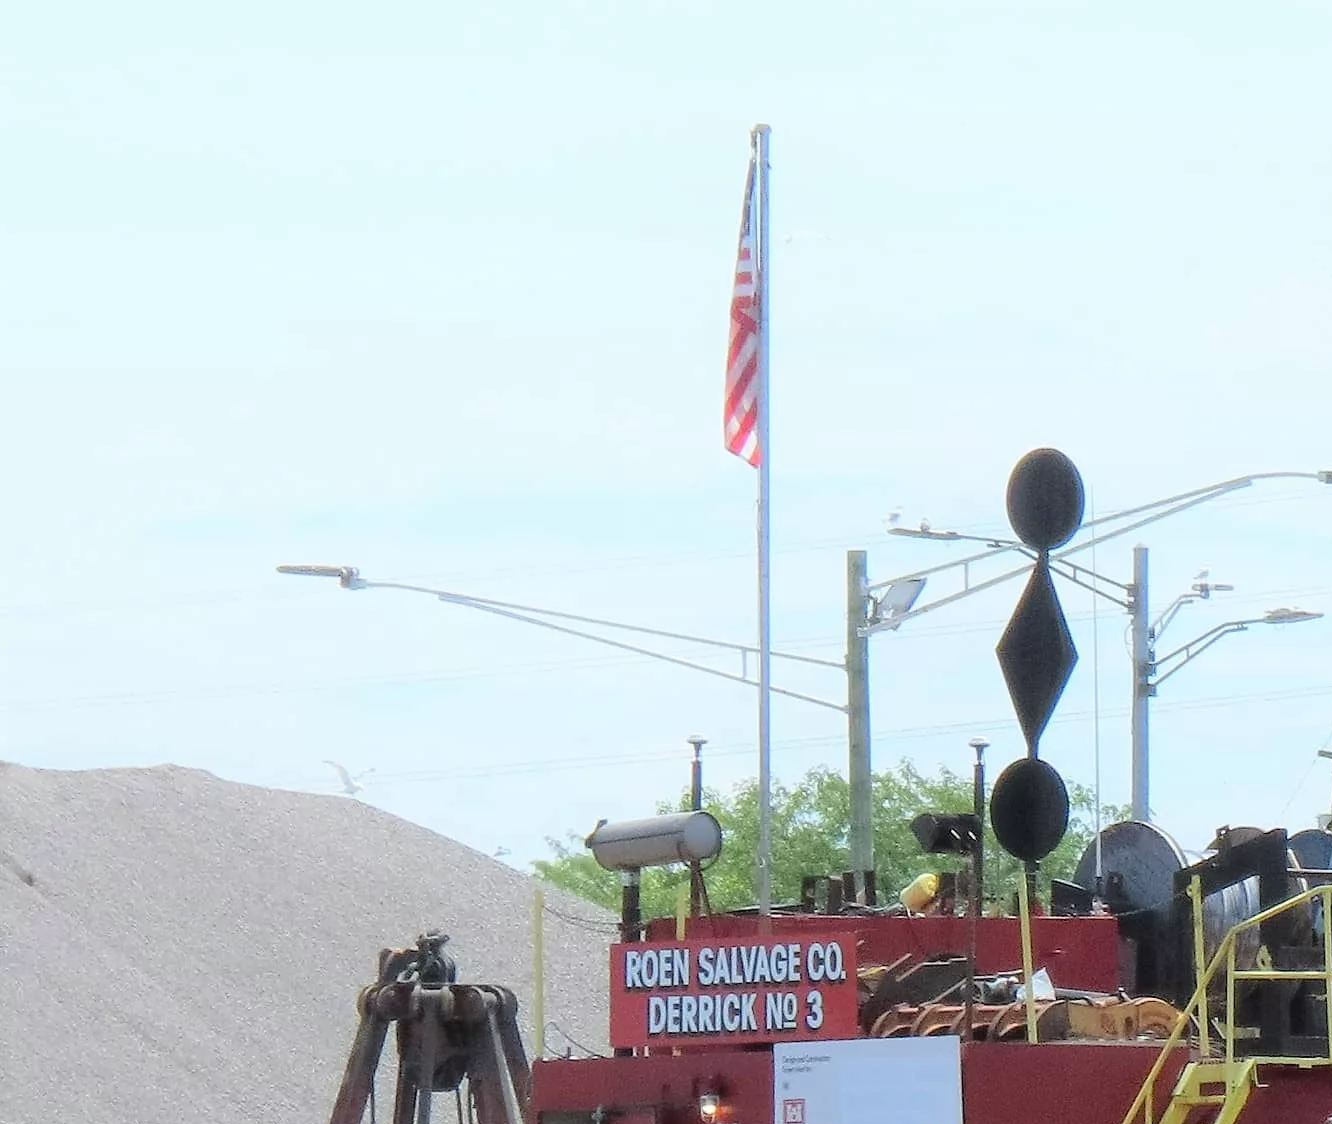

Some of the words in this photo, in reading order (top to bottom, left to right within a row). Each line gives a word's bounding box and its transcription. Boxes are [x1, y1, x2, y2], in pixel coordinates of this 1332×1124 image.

[626, 949, 690, 988] ROEN
[698, 943, 801, 986] SALVAGE
[807, 942, 847, 982] CO.
[648, 993, 758, 1034] DERRICK
[806, 990, 824, 1029] 3
